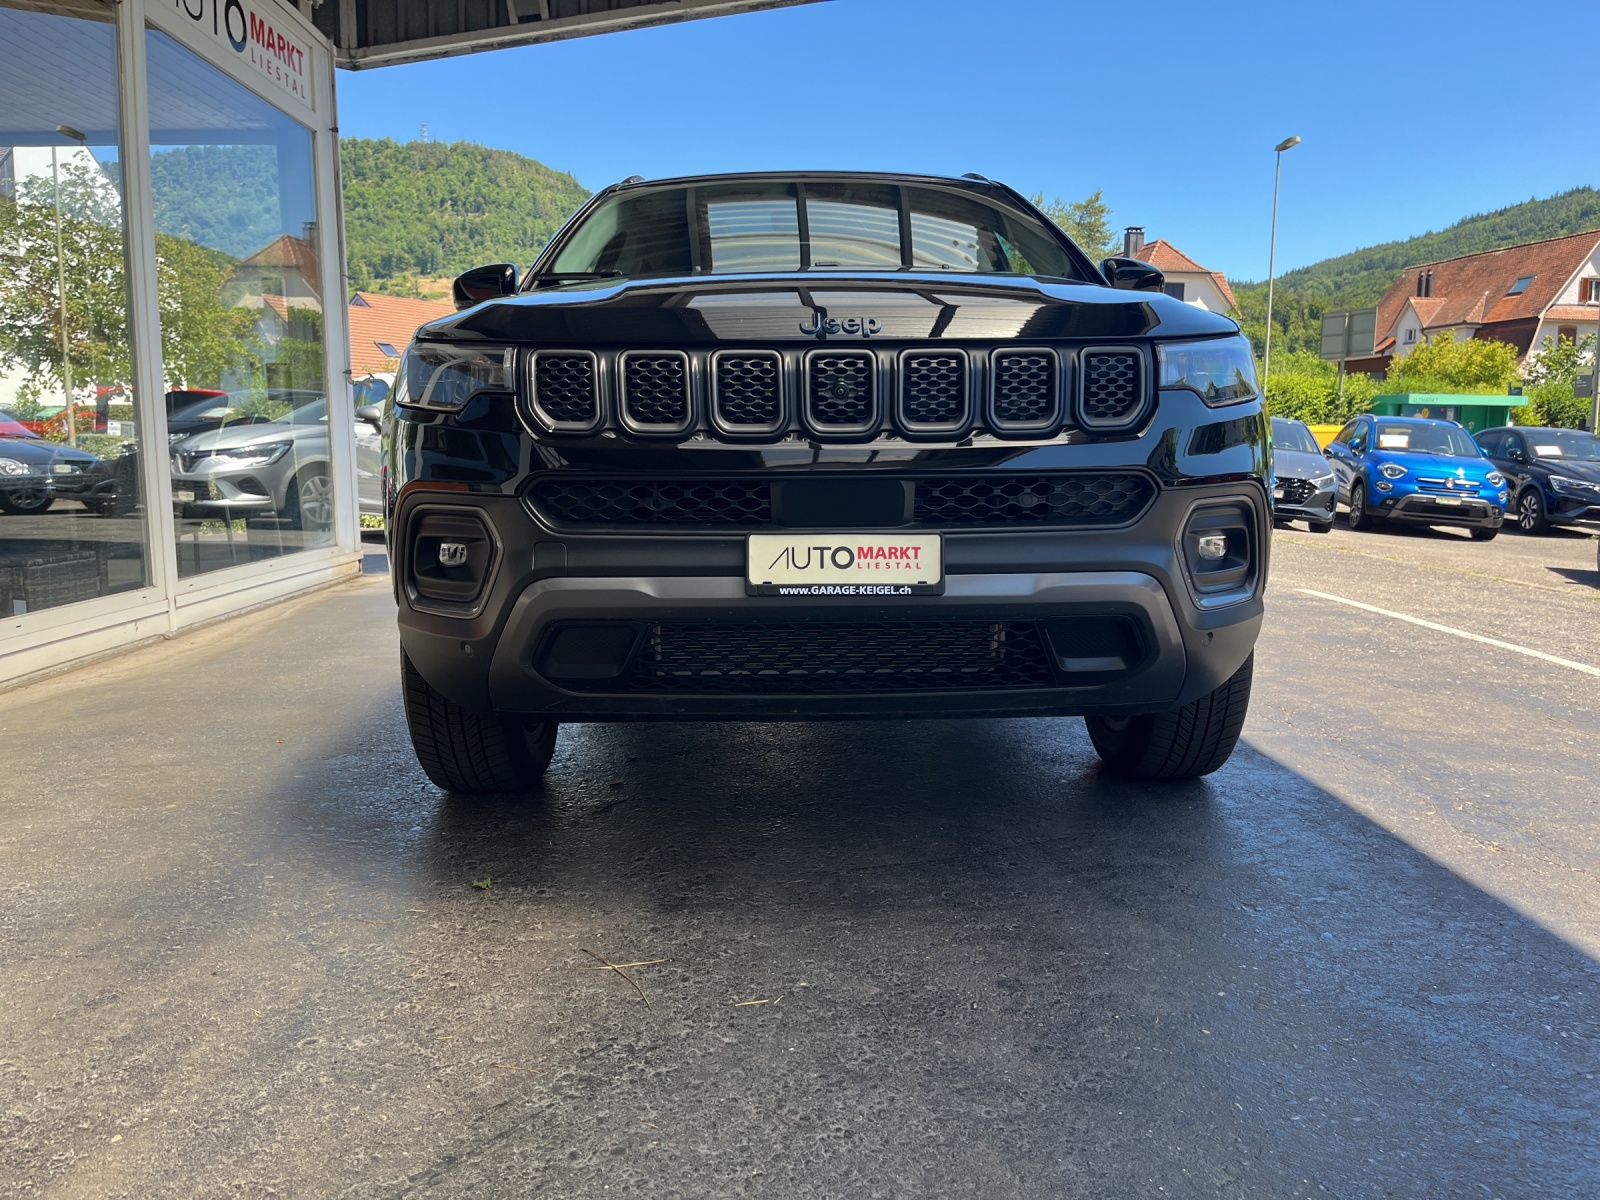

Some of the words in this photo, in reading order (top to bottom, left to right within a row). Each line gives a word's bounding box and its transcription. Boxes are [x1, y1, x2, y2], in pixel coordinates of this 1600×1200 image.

[175, 0, 247, 52] TO
[250, 11, 304, 76] MARKT
[251, 48, 305, 99] LIESTAL
[799, 312, 882, 338] Jeep
[768, 546, 855, 569] AUTO
[857, 546, 921, 560] MARKT
[857, 562, 921, 570] LIESTAL
[779, 586, 912, 595] www.GARAGE-KEIGEL.ch
